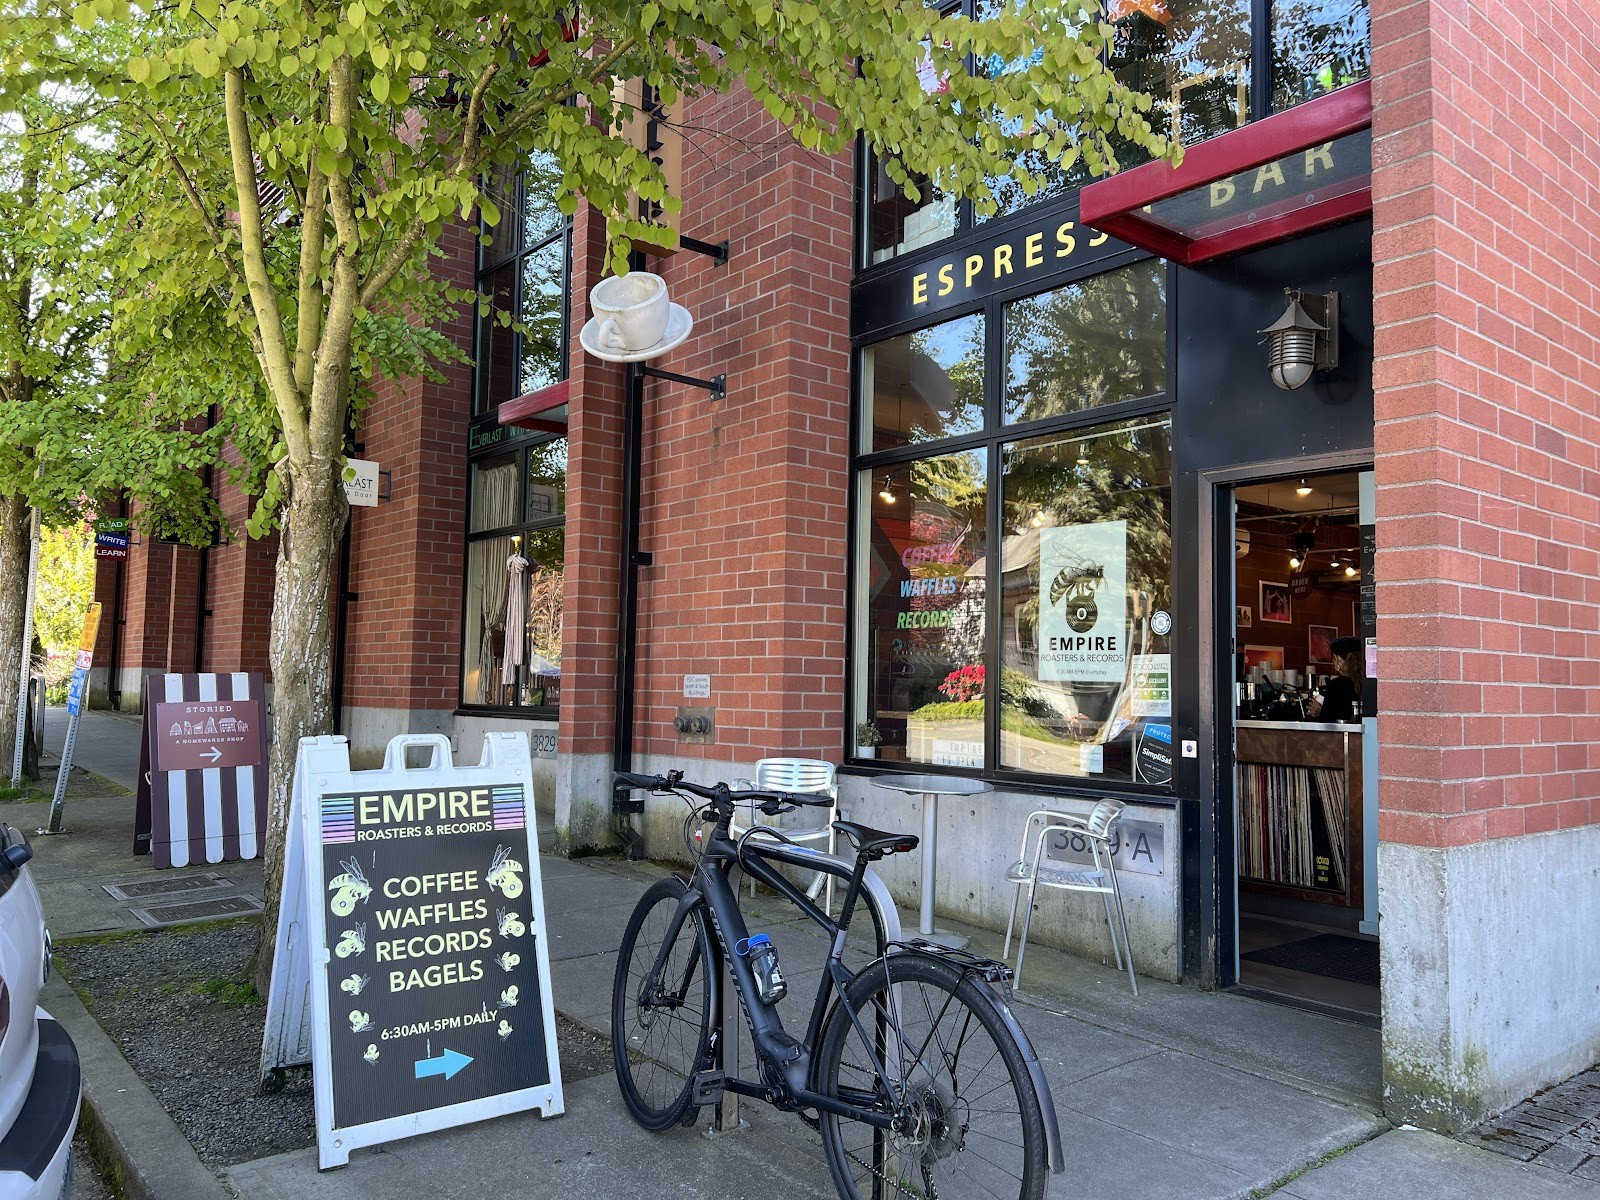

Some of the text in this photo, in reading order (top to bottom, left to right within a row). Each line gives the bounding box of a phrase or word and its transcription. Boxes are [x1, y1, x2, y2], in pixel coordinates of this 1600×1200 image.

[1210, 141, 1335, 208] BAR
[913, 221, 1109, 305] ESPRES
[98, 521, 123, 529] RAD
[98, 533, 127, 546] WRITE
[96, 549, 126, 557] LEARN
[901, 542, 955, 568] COFFEE
[900, 576, 957, 598] WAFFLES
[897, 609, 956, 629] RECORDS
[1049, 636, 1117, 651] EMPIRE
[1041, 653, 1079, 662] ROASTERS
[1079, 653, 1086, 662] &
[1087, 653, 1124, 663] RECORDS
[186, 705, 233, 714] STORIED
[182, 736, 225, 745] HOMEWARES
[1149, 727, 1171, 740] PROTEC
[950, 742, 983, 754] EMPIRE
[1141, 747, 1172, 766] SimpliSaf
[942, 754, 976, 767] IS OPEN
[359, 789, 491, 825] EMPIRE
[357, 820, 493, 842] ROASTERS & RECORDS
[382, 870, 479, 899] COFFEE
[375, 898, 488, 931] WAFFLES
[375, 927, 493, 962] RECORDS
[389, 959, 484, 993] BAGELS
[380, 1009, 498, 1041] 6:30AM-5PM DAILY
